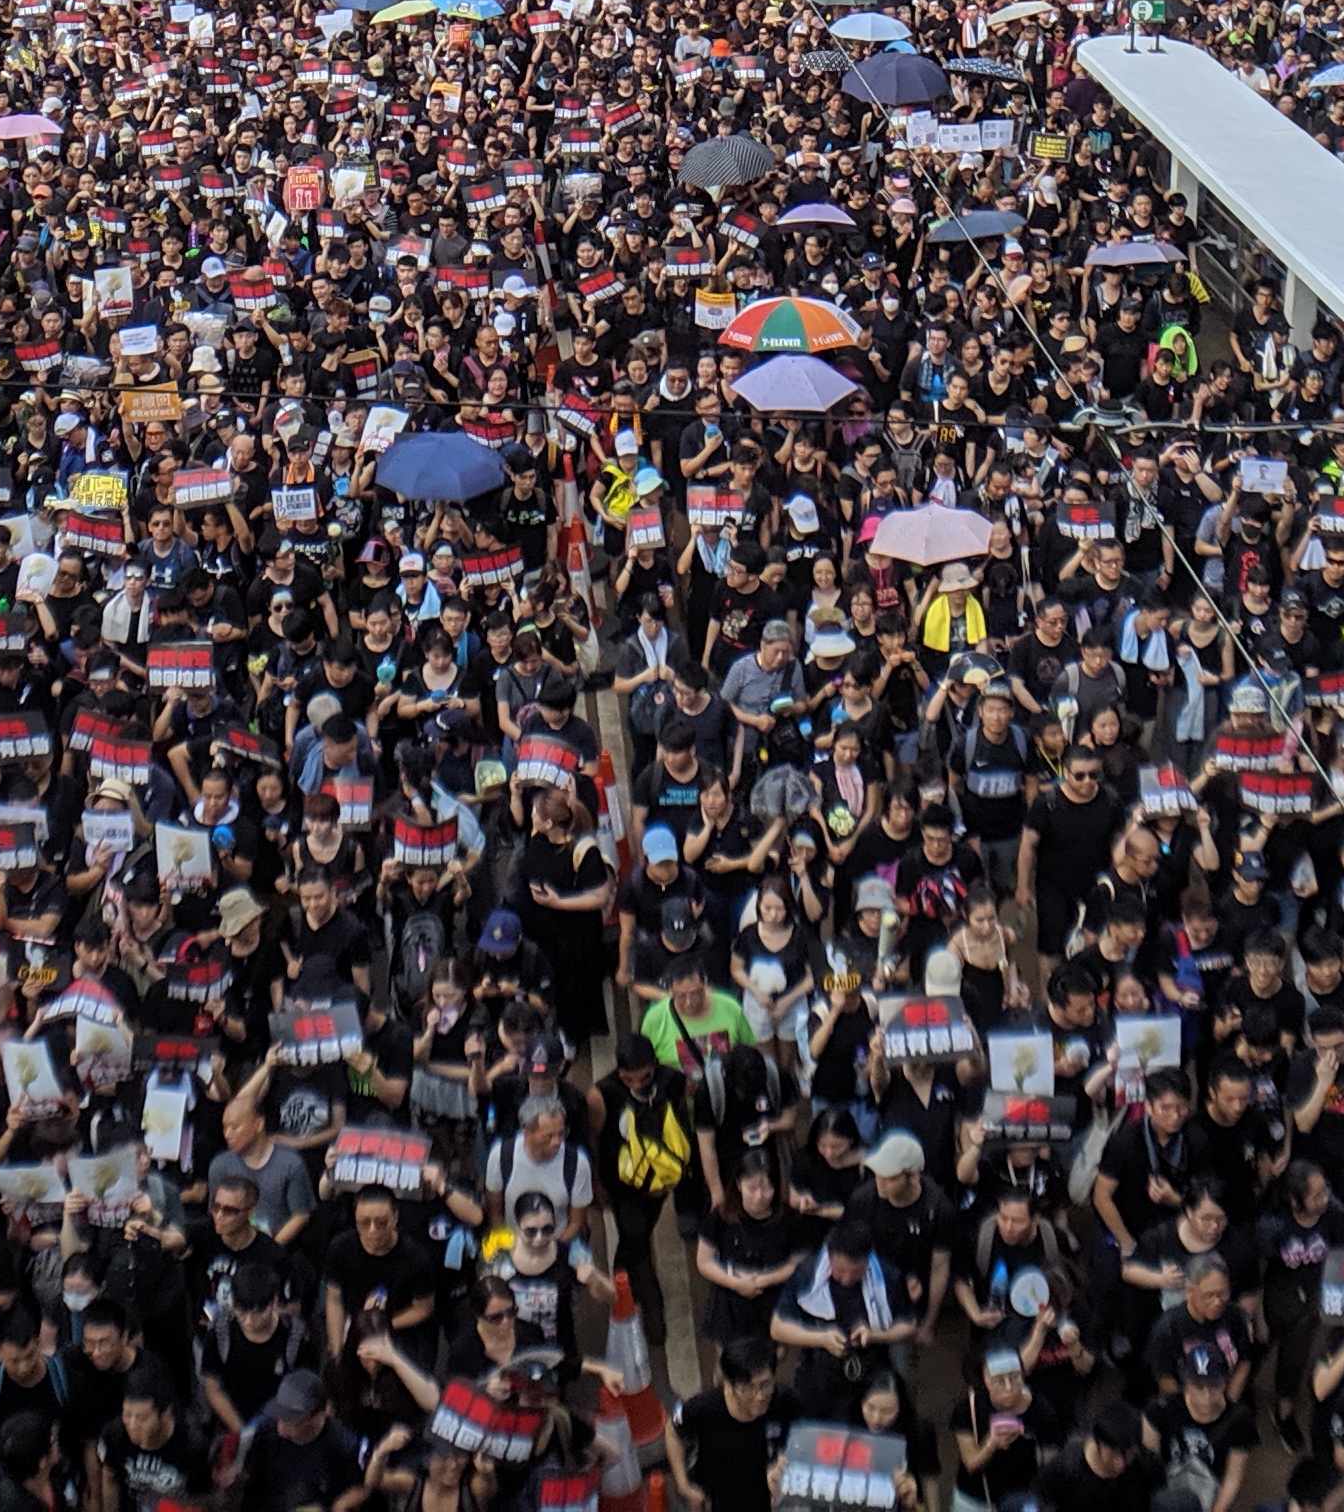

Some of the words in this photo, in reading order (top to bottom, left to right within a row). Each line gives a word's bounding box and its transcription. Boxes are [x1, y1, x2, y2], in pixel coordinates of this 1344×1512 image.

[761, 337, 802, 348] 7-ELEVEN
[811, 331, 846, 347] 7-ELEVEN
[130, 409, 176, 418] #Retract
